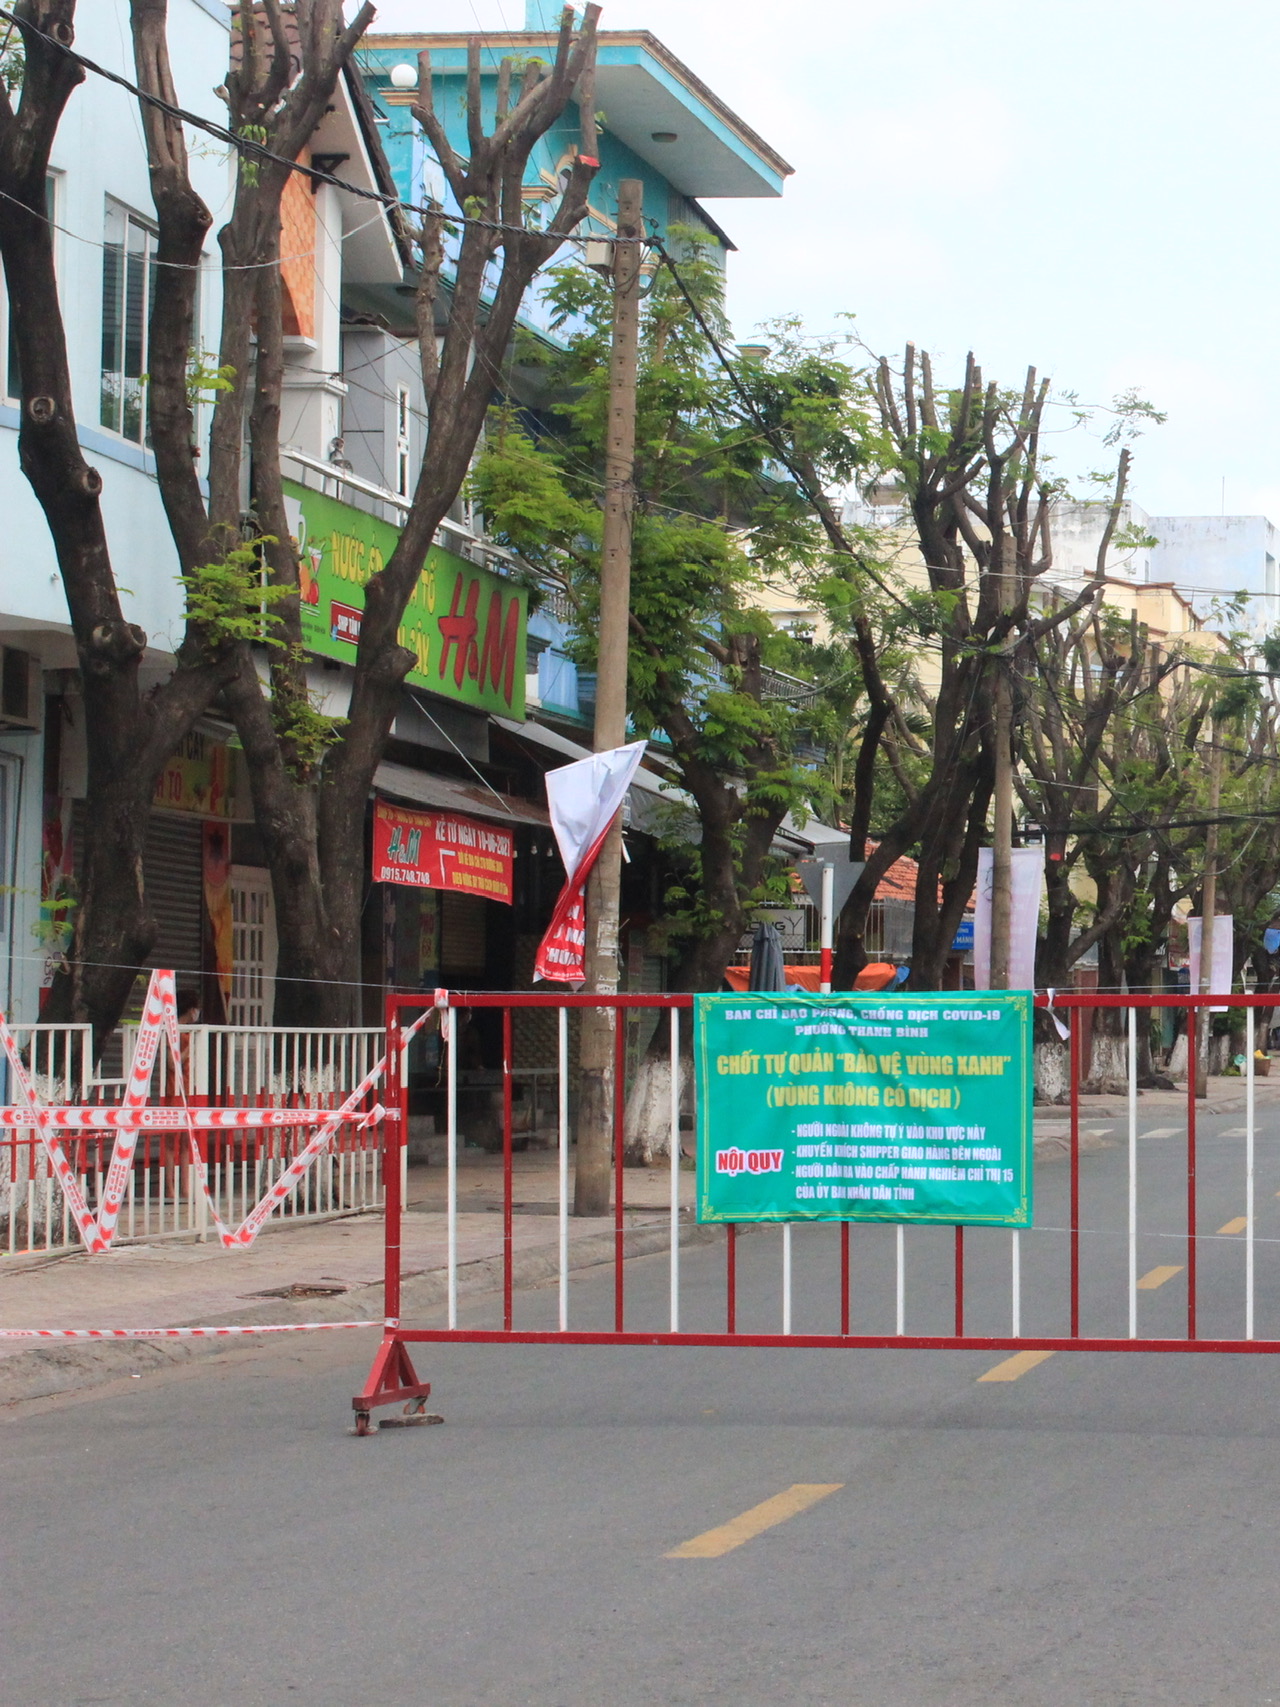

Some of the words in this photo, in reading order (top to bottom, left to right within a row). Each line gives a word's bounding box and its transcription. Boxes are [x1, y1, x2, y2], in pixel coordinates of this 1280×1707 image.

[380, 866, 431, 885] 0915.748.748
[725, 1009, 752, 1020] BAN
[756, 1006, 778, 1020] CHỈ
[861, 1006, 904, 1020] CHỐNG
[908, 1009, 939, 1023] DỊCH
[943, 1009, 1001, 1021] COVID-19
[848, 1025, 892, 1038] THANH
[896, 1025, 929, 1038] BÌNH
[716, 1049, 761, 1076] CHỐT
[763, 1051, 788, 1079] TỰ
[789, 1046, 834, 1075] QUẢN
[879, 1051, 902, 1079] VỆ
[905, 1050, 954, 1076] VÙNG
[766, 1081, 820, 1109] (VÙNG
[823, 1081, 880, 1107] KHÔNG
[883, 1083, 906, 1107] CÓ
[850, 1122, 882, 1138] KHÔNG
[906, 1122, 924, 1139] VÀO
[926, 1126, 944, 1139] KHU
[945, 1125, 965, 1143] VỰC
[966, 1124, 986, 1140] NÀY
[718, 1149, 744, 1175] NỘI
[748, 1151, 782, 1172] QUY
[860, 1145, 899, 1159] SHIPPER
[901, 1146, 924, 1159] GIAO
[926, 1144, 950, 1160] HÀNG
[952, 1145, 971, 1160] BÊN
[972, 1145, 1002, 1161] NGOÀI
[854, 1162, 874, 1179] VÀO
[875, 1162, 900, 1179] CHẤP
[901, 1163, 927, 1180] HÀNH
[967, 1164, 984, 1181] CHỈ
[985, 1167, 1001, 1185] THỊ
[1002, 1169, 1014, 1182] 15
[796, 1182, 815, 1199] CỦA
[872, 1184, 892, 1200] DÂN
